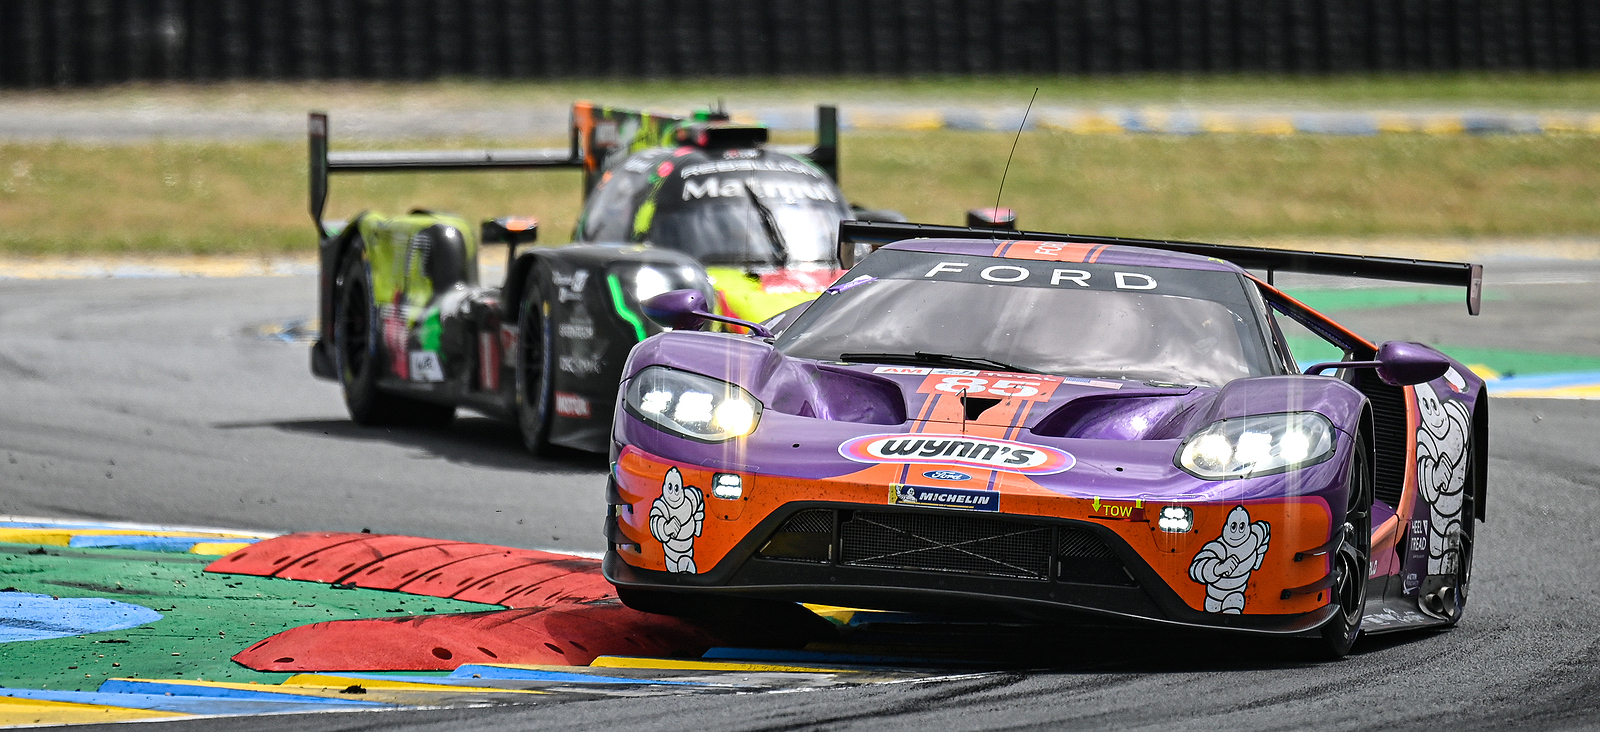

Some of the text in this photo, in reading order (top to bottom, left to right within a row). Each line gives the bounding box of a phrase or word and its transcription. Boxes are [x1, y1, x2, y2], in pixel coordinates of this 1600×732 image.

[924, 261, 1158, 290] FORD
[983, 372, 1057, 382] TOTAL
[934, 376, 1041, 397] 85
[932, 470, 963, 480] Ford
[918, 491, 991, 505] MICHELIN
[1102, 504, 1133, 518] TOW
